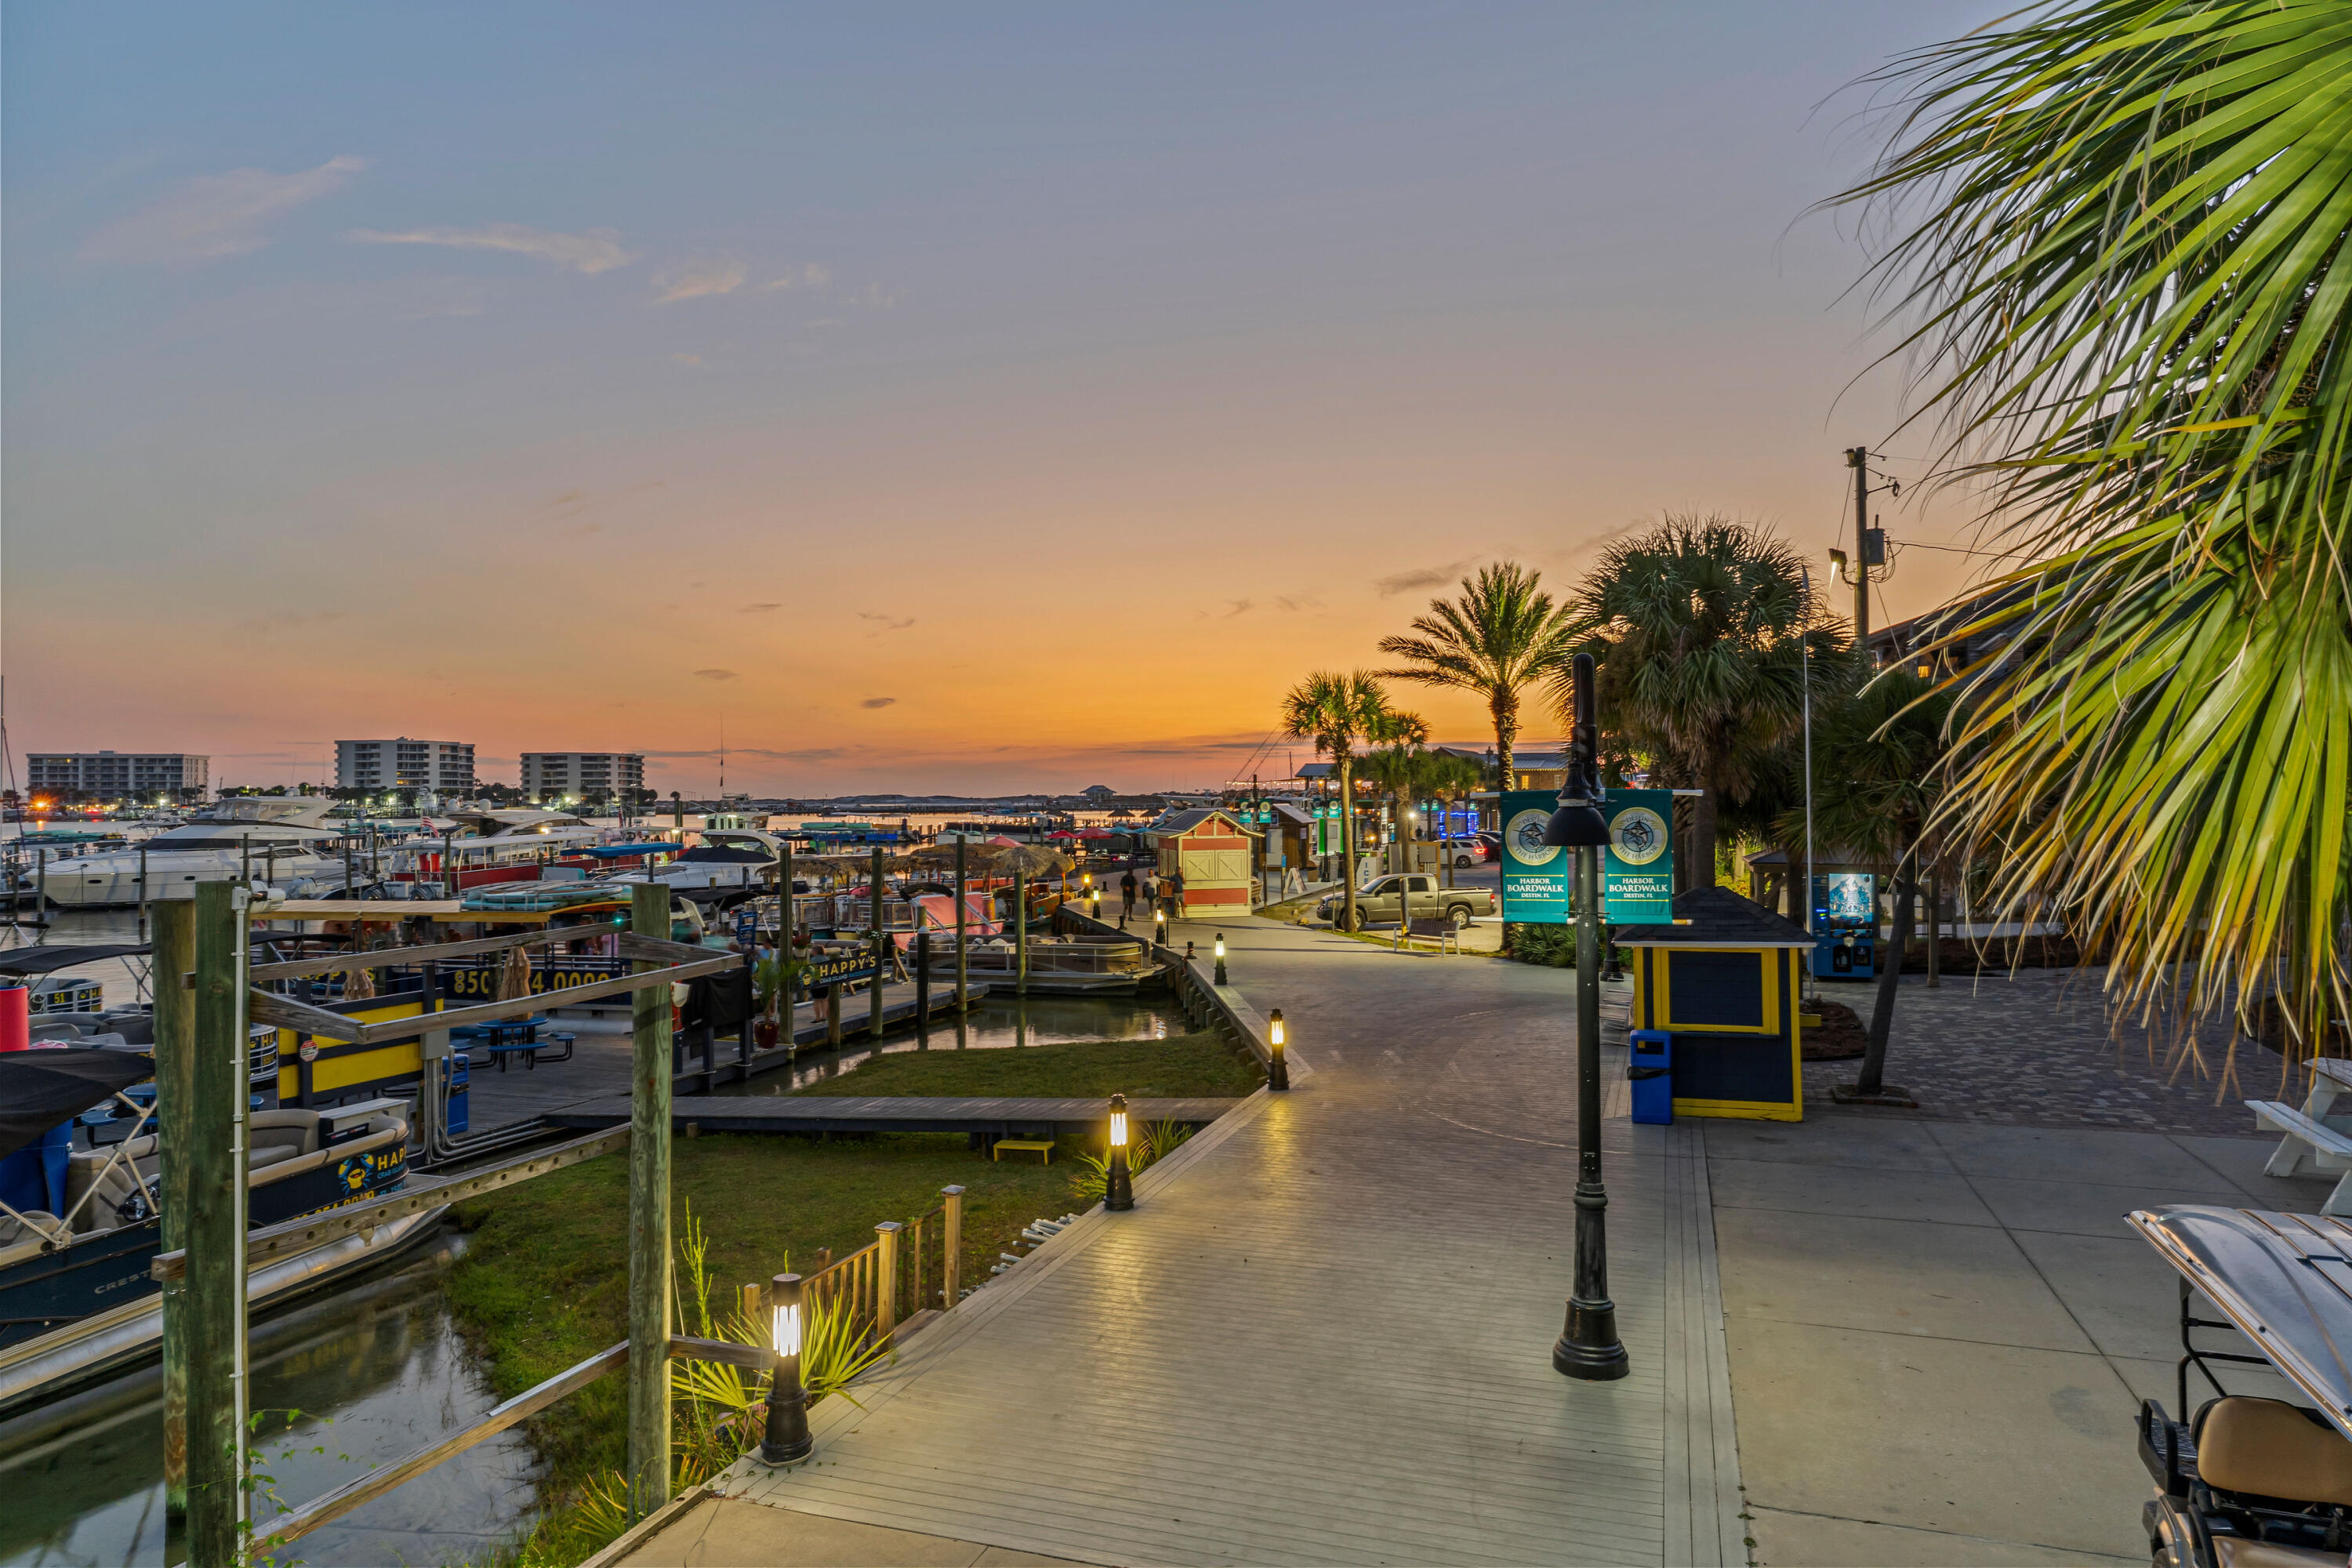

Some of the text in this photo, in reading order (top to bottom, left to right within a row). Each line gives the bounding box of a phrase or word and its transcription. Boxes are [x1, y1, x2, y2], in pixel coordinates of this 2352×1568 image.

[1515, 846, 1554, 860] THE HARBOR
[1618, 845, 1658, 860] THE HARBOR
[819, 956, 876, 977] HAPPY'S
[53, 993, 66, 1004] 51
